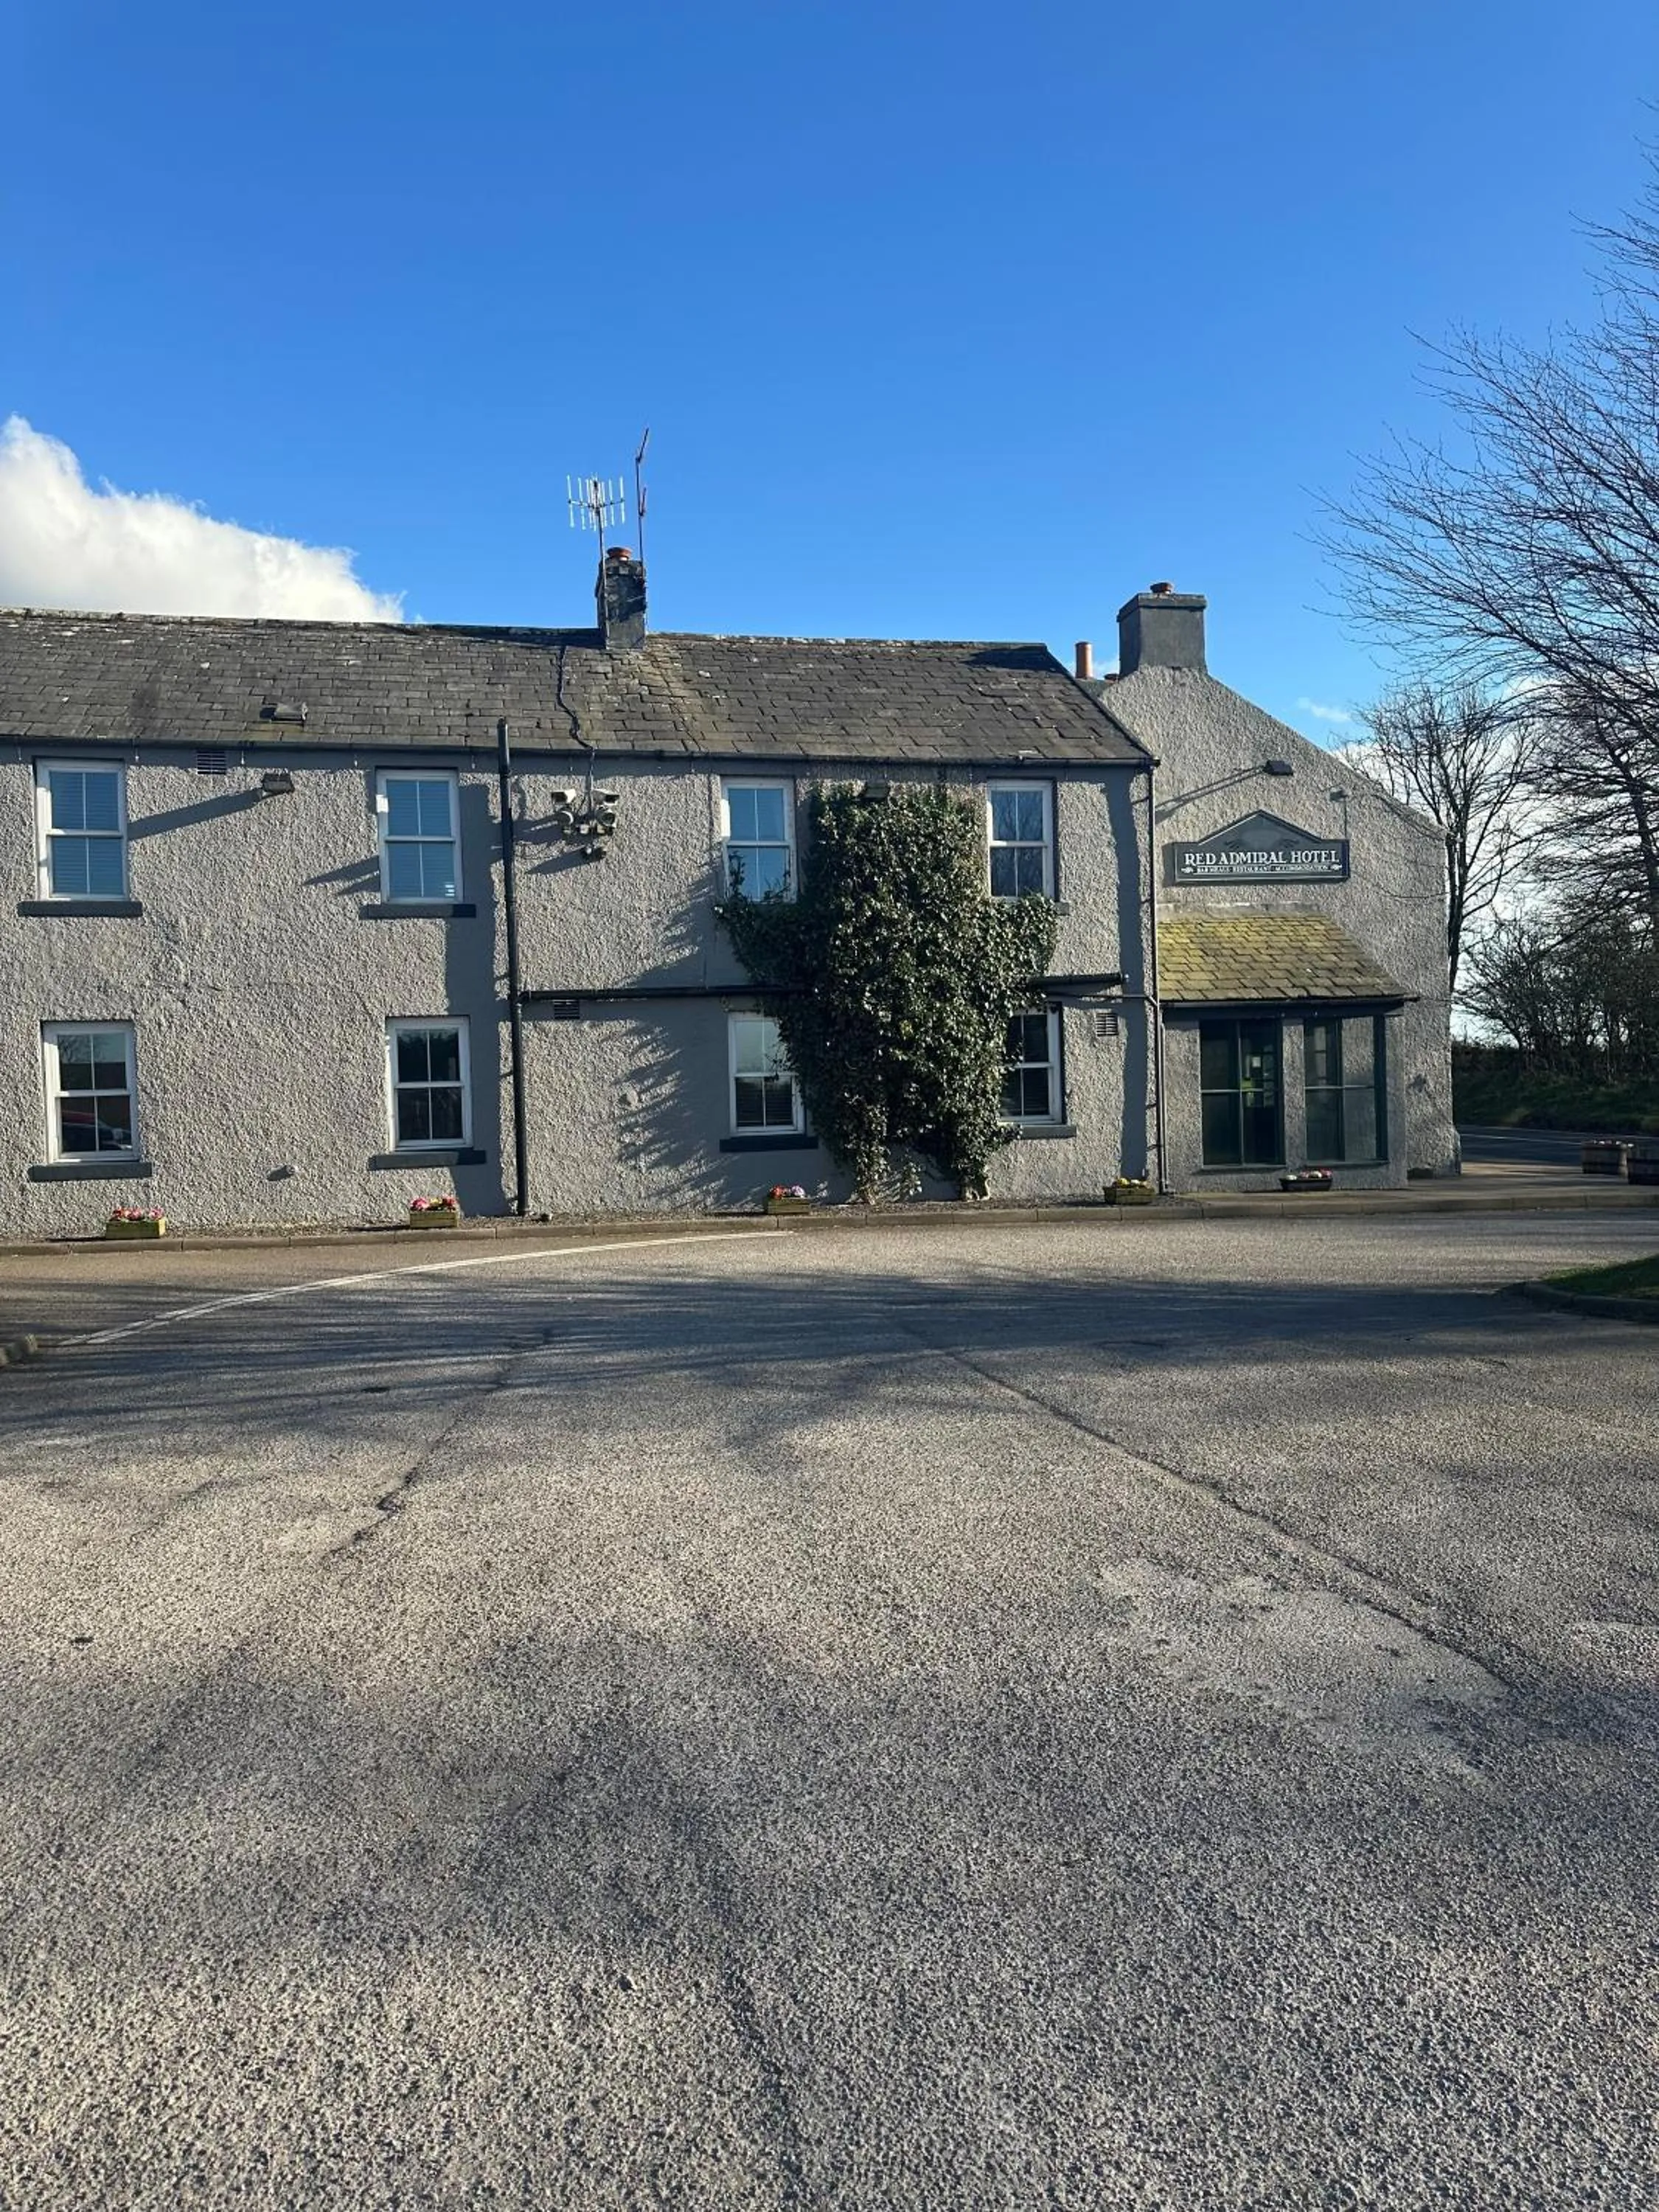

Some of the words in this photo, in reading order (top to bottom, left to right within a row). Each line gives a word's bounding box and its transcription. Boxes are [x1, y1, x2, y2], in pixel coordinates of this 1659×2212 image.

[1185, 853, 1216, 866] RED
[1219, 852, 1286, 865] ADMIRAL
[1291, 850, 1339, 863] HOTEL
